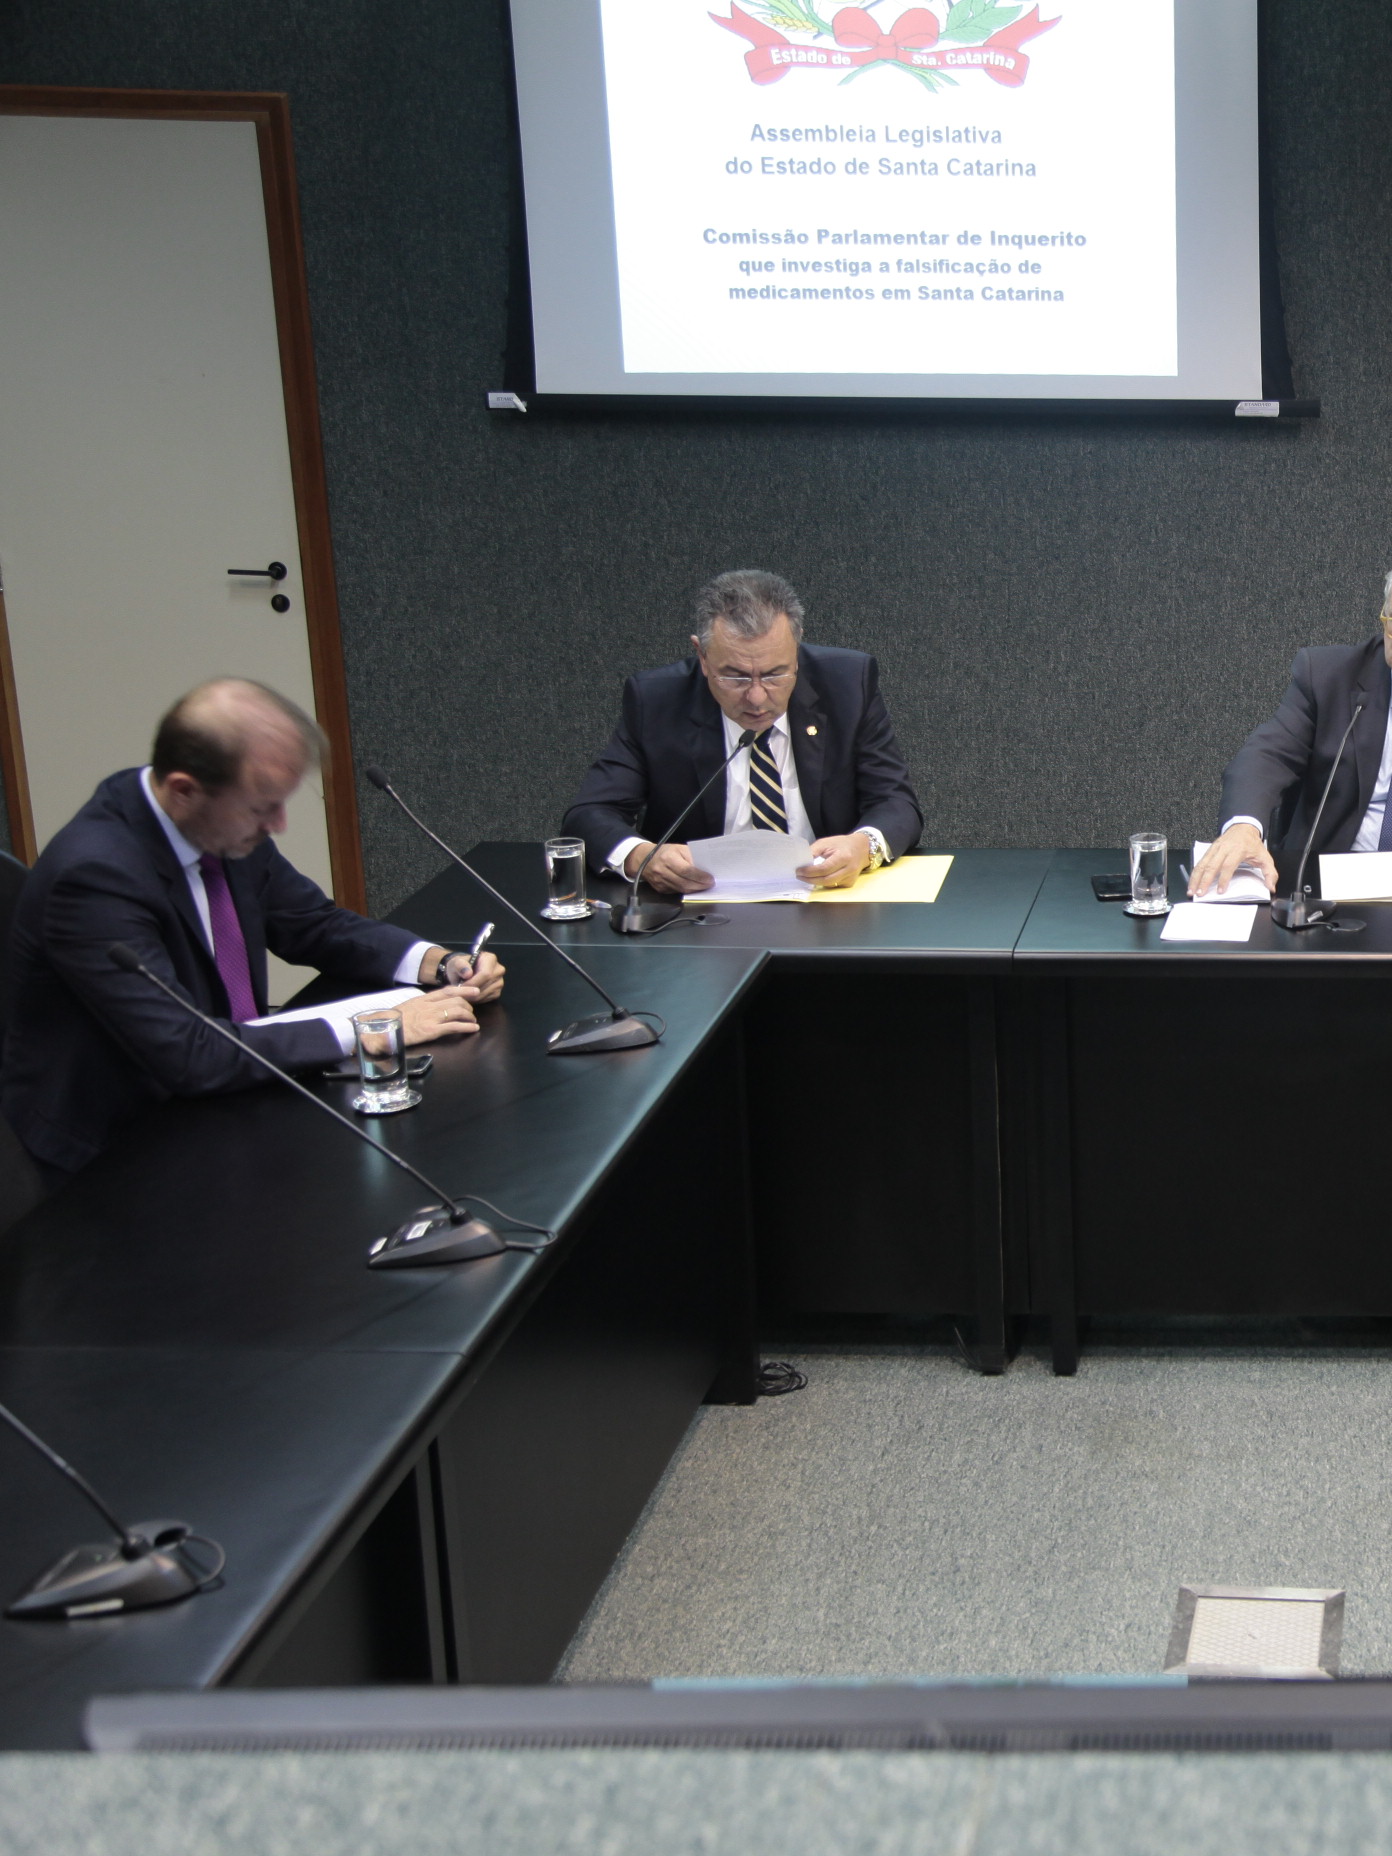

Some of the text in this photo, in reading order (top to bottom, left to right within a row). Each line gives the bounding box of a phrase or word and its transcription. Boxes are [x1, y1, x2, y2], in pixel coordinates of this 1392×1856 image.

[770, 48, 852, 66] Estado de
[911, 51, 1017, 71] Sta. Catarina
[750, 123, 1003, 148] Assembleia Legislativa
[725, 156, 1037, 177] do Estado de Santa Catarina
[702, 227, 1087, 249] Comissão Parlamentar de Inquerito
[738, 257, 1042, 277] que investiga a falsificação de
[728, 284, 1065, 302] medicamentos em Santa Catarina
